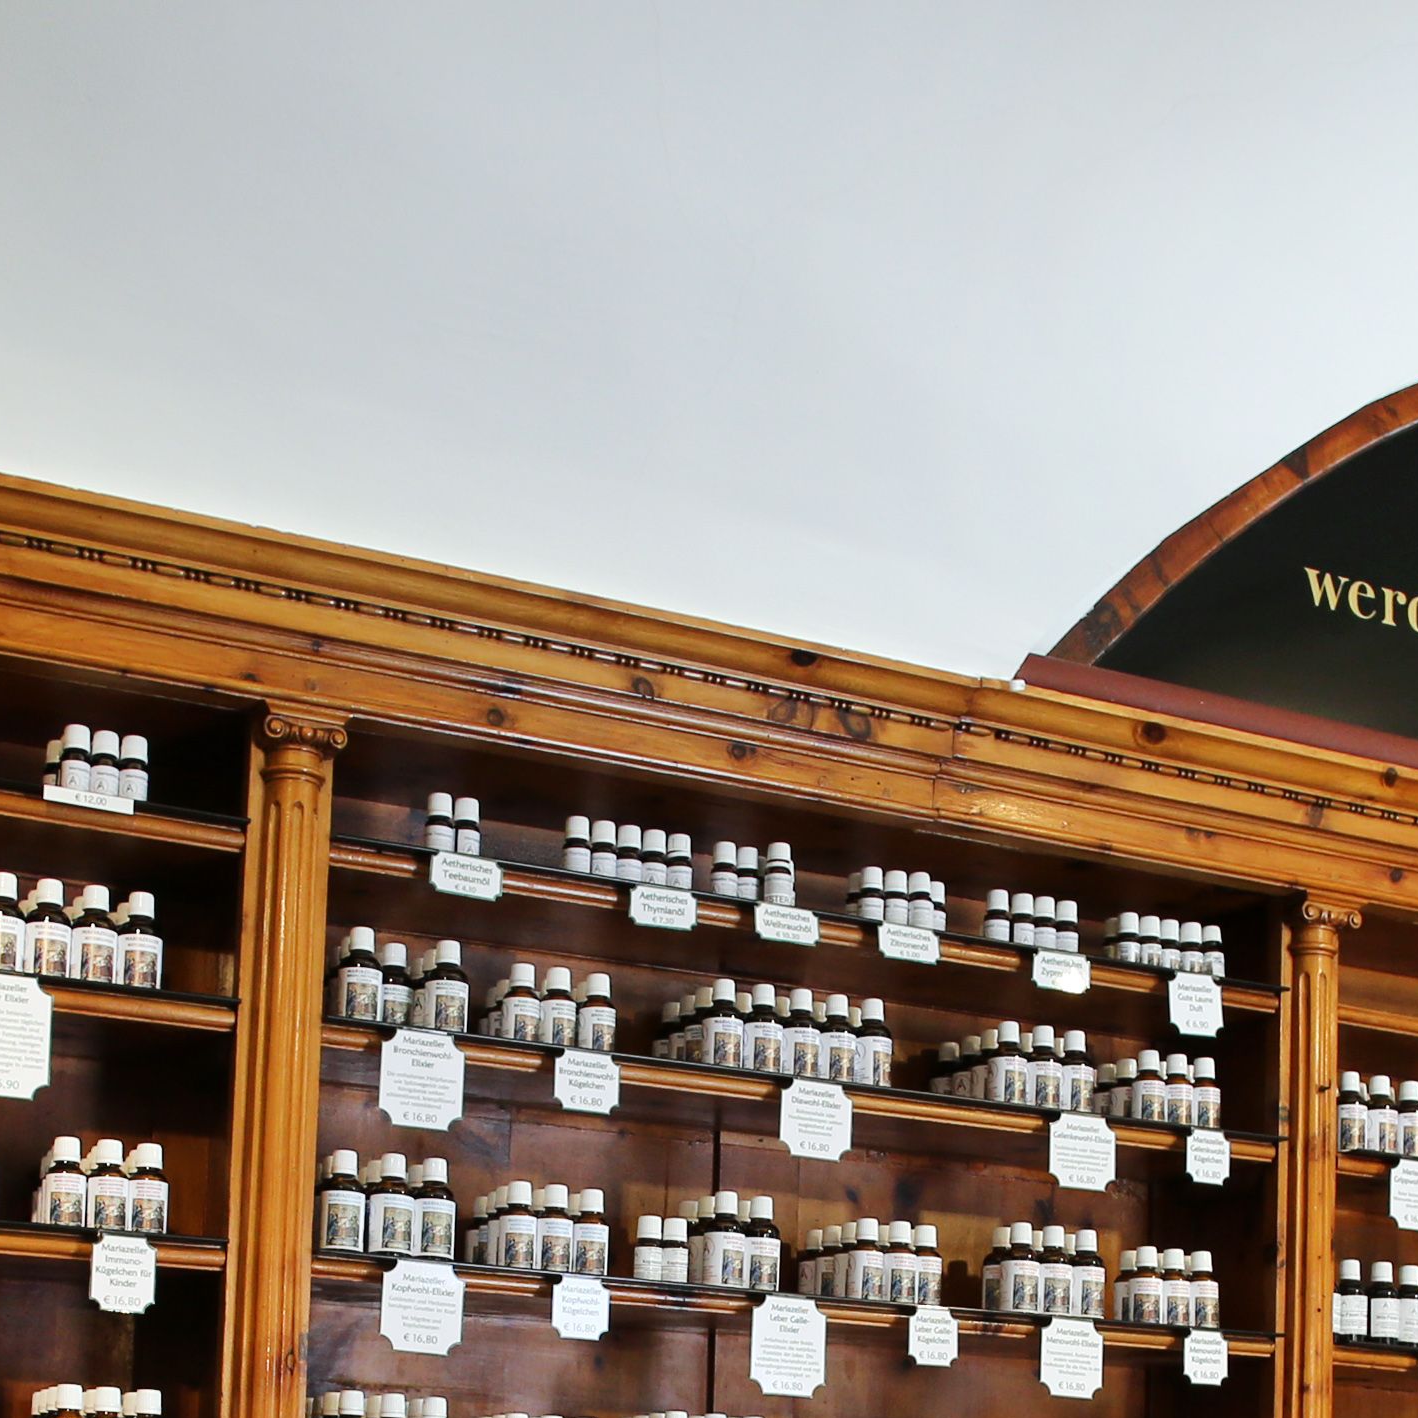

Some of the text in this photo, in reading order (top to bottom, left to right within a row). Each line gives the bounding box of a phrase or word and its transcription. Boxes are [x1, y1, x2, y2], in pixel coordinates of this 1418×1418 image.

[441, 857, 493, 875] Aetherisches
[442, 869, 491, 886] Teebaumöl
[639, 890, 688, 906] Aetherisches
[4, 993, 30, 1005] Elixier
[403, 1036, 445, 1048] Mariazeller
[411, 1059, 435, 1069] Elixier
[567, 1057, 608, 1070] Mariazeller
[568, 1080, 606, 1091] Kügelchen
[101, 1243, 147, 1255] Mariazeller
[105, 1255, 143, 1265] Immuno-
[95, 1266, 152, 1278] Kügelchen für
[109, 1278, 137, 1288] Kinder
[402, 1273, 445, 1285] Mariazeller
[391, 1283, 455, 1297] Kopfwohl-Elixier
